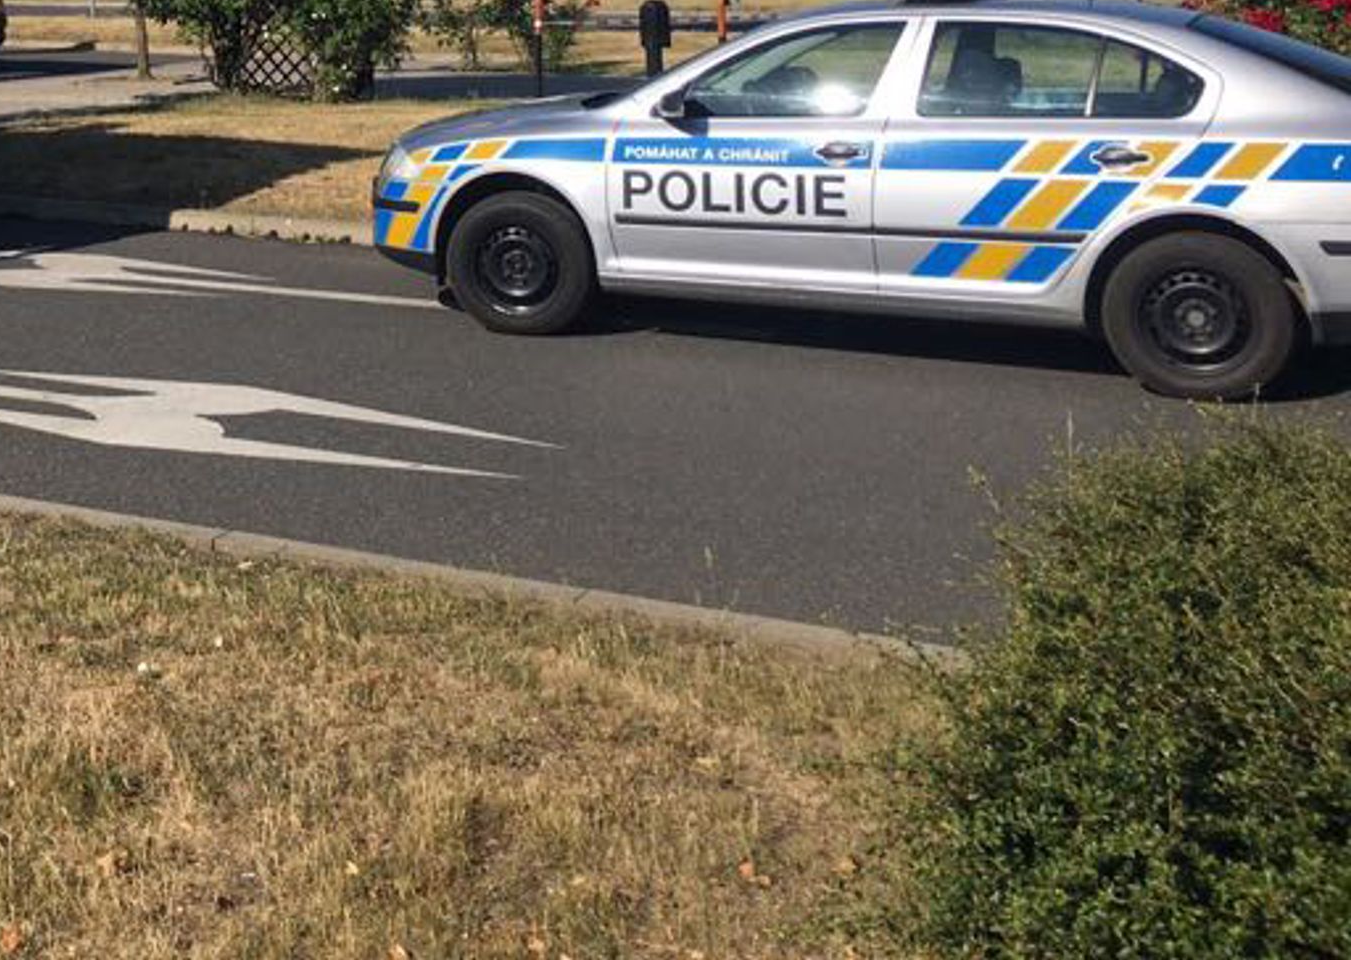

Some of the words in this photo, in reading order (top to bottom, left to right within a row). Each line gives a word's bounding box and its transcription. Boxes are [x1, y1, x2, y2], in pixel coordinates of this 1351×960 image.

[624, 144, 698, 160] POMÁHAT
[703, 147, 714, 160] A
[623, 170, 847, 217] POLICIE
